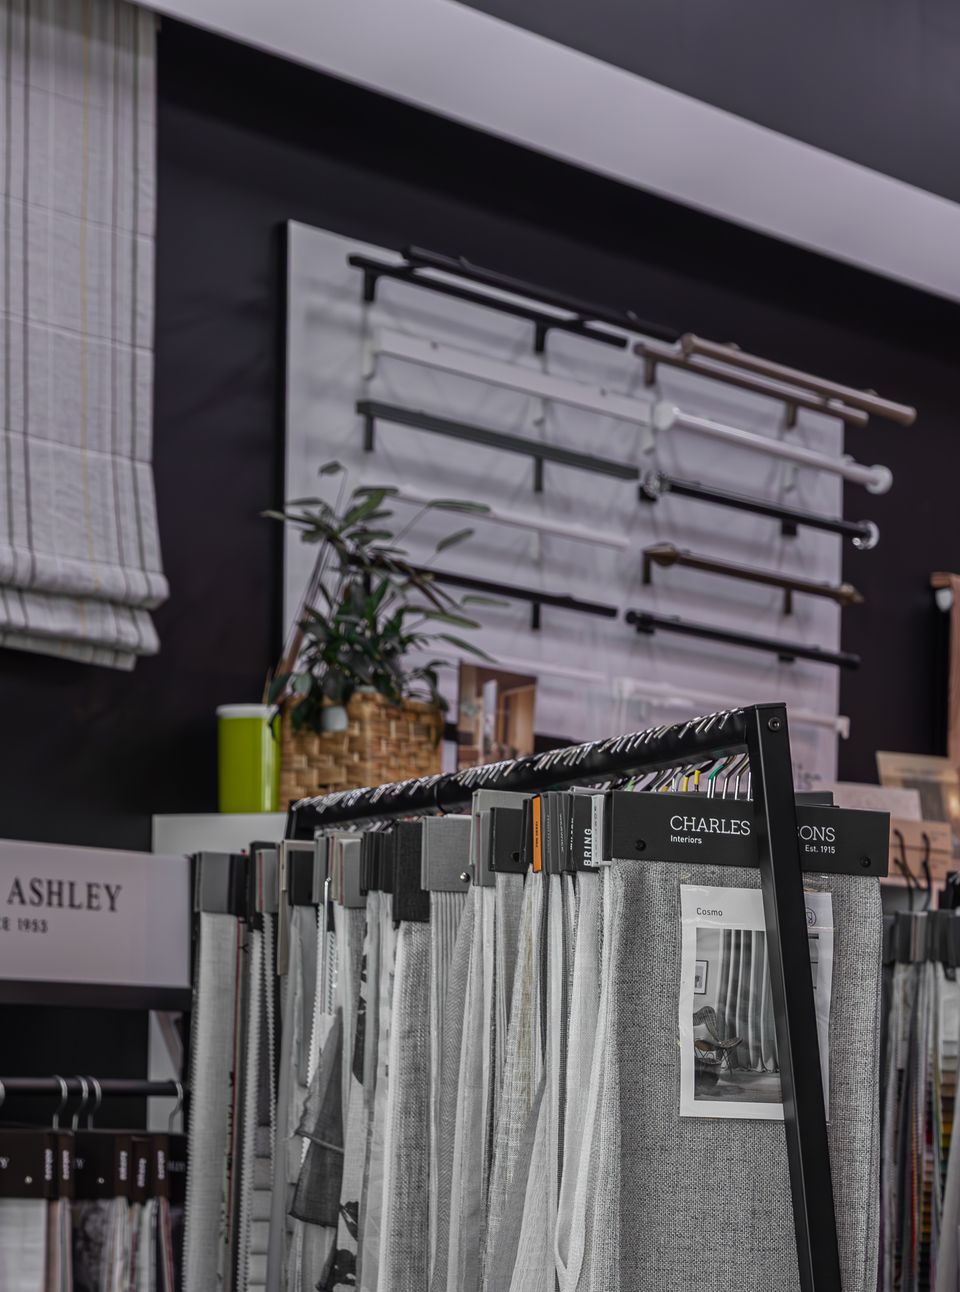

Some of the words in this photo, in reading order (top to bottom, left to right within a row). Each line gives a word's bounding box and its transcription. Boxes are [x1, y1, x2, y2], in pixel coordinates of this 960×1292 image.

[670, 815, 751, 836] CHARLES
[583, 828, 592, 866] BRING
[670, 835, 703, 845] Interiors
[804, 844, 819, 854] Est.
[820, 845, 836, 855] 1915
[6, 876, 123, 913] ASHLEY
[696, 907, 723, 917] Cosmo
